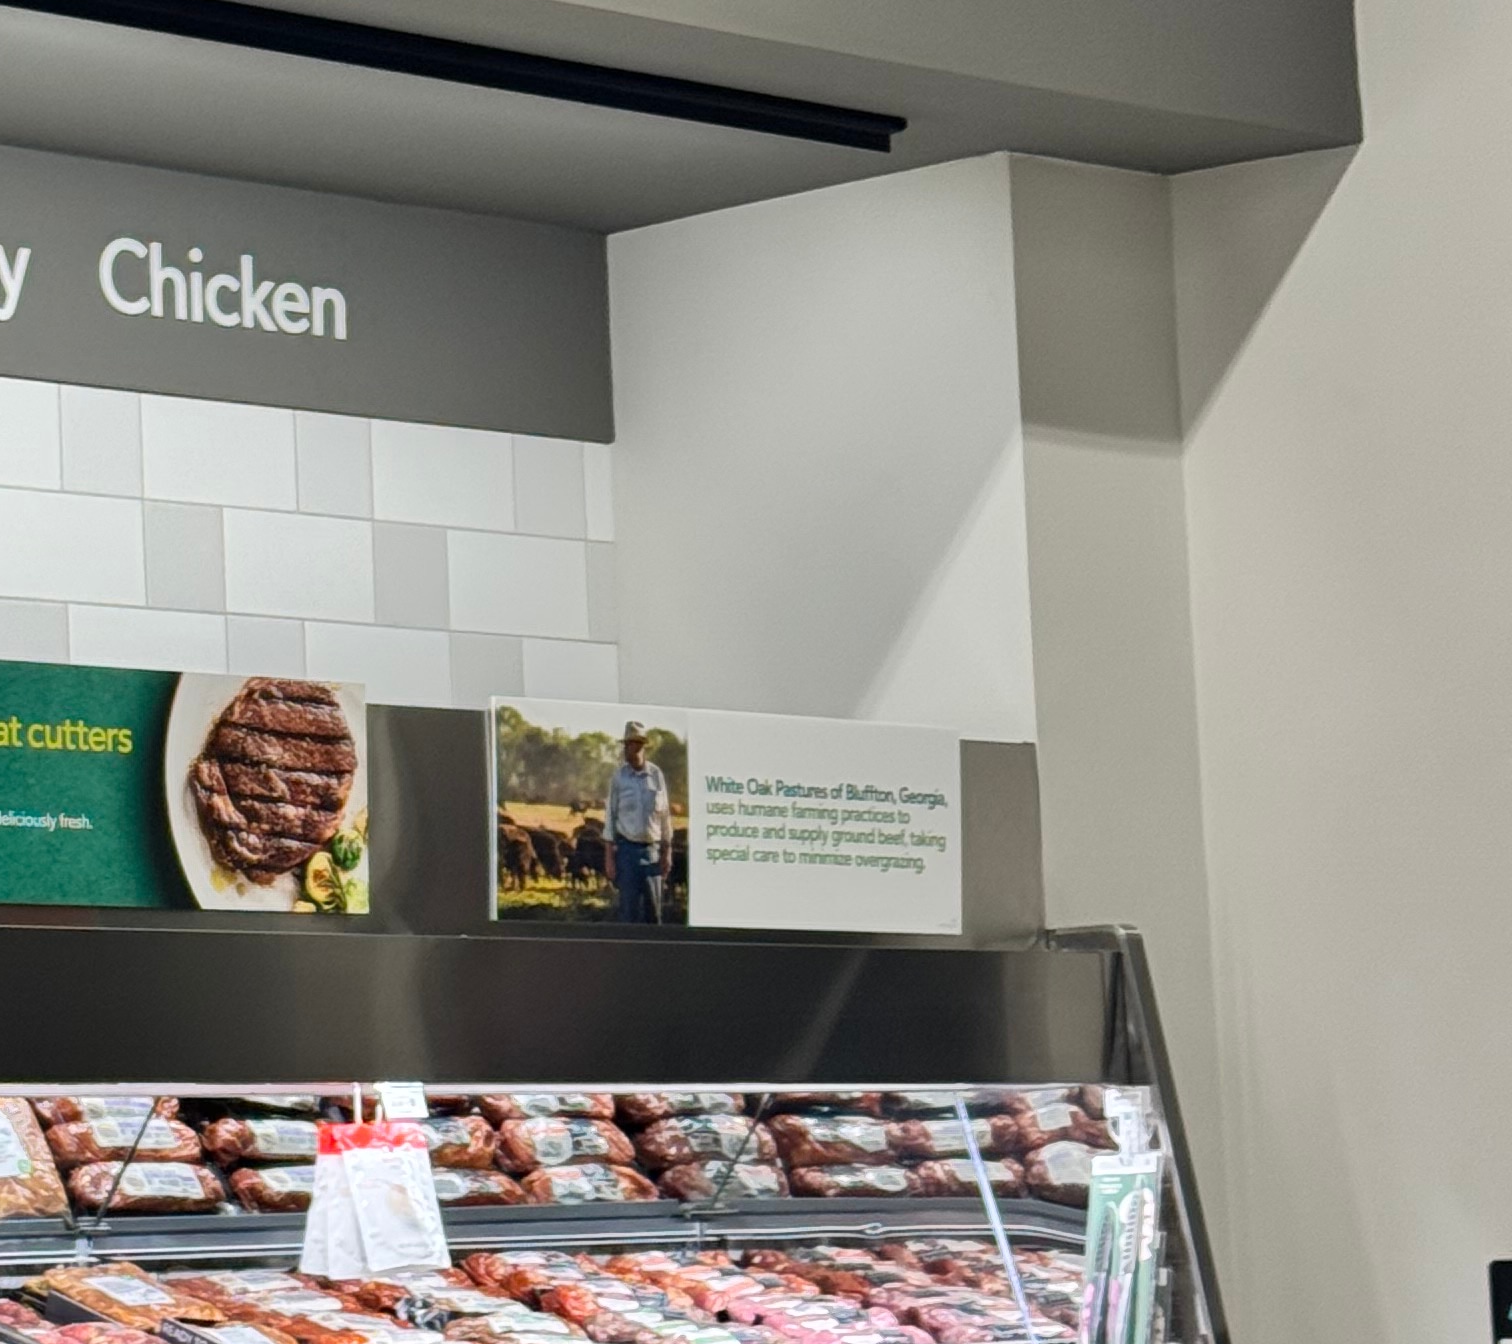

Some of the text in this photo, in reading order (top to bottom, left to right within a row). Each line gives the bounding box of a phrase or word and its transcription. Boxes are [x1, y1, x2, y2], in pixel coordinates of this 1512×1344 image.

[98, 237, 348, 341] Chicken
[26, 720, 133, 754] cutters
[705, 776, 744, 795] White
[747, 778, 773, 796] Oak
[775, 780, 828, 799] Pastures
[830, 783, 844, 798] of
[898, 787, 948, 810] Georgia,
[58, 812, 93, 830] fresh.
[706, 800, 910, 825] uses humane farming practices to
[706, 822, 947, 852] produce and supply ground beef, taking
[706, 845, 926, 874] special care to minimize overgrazing.
